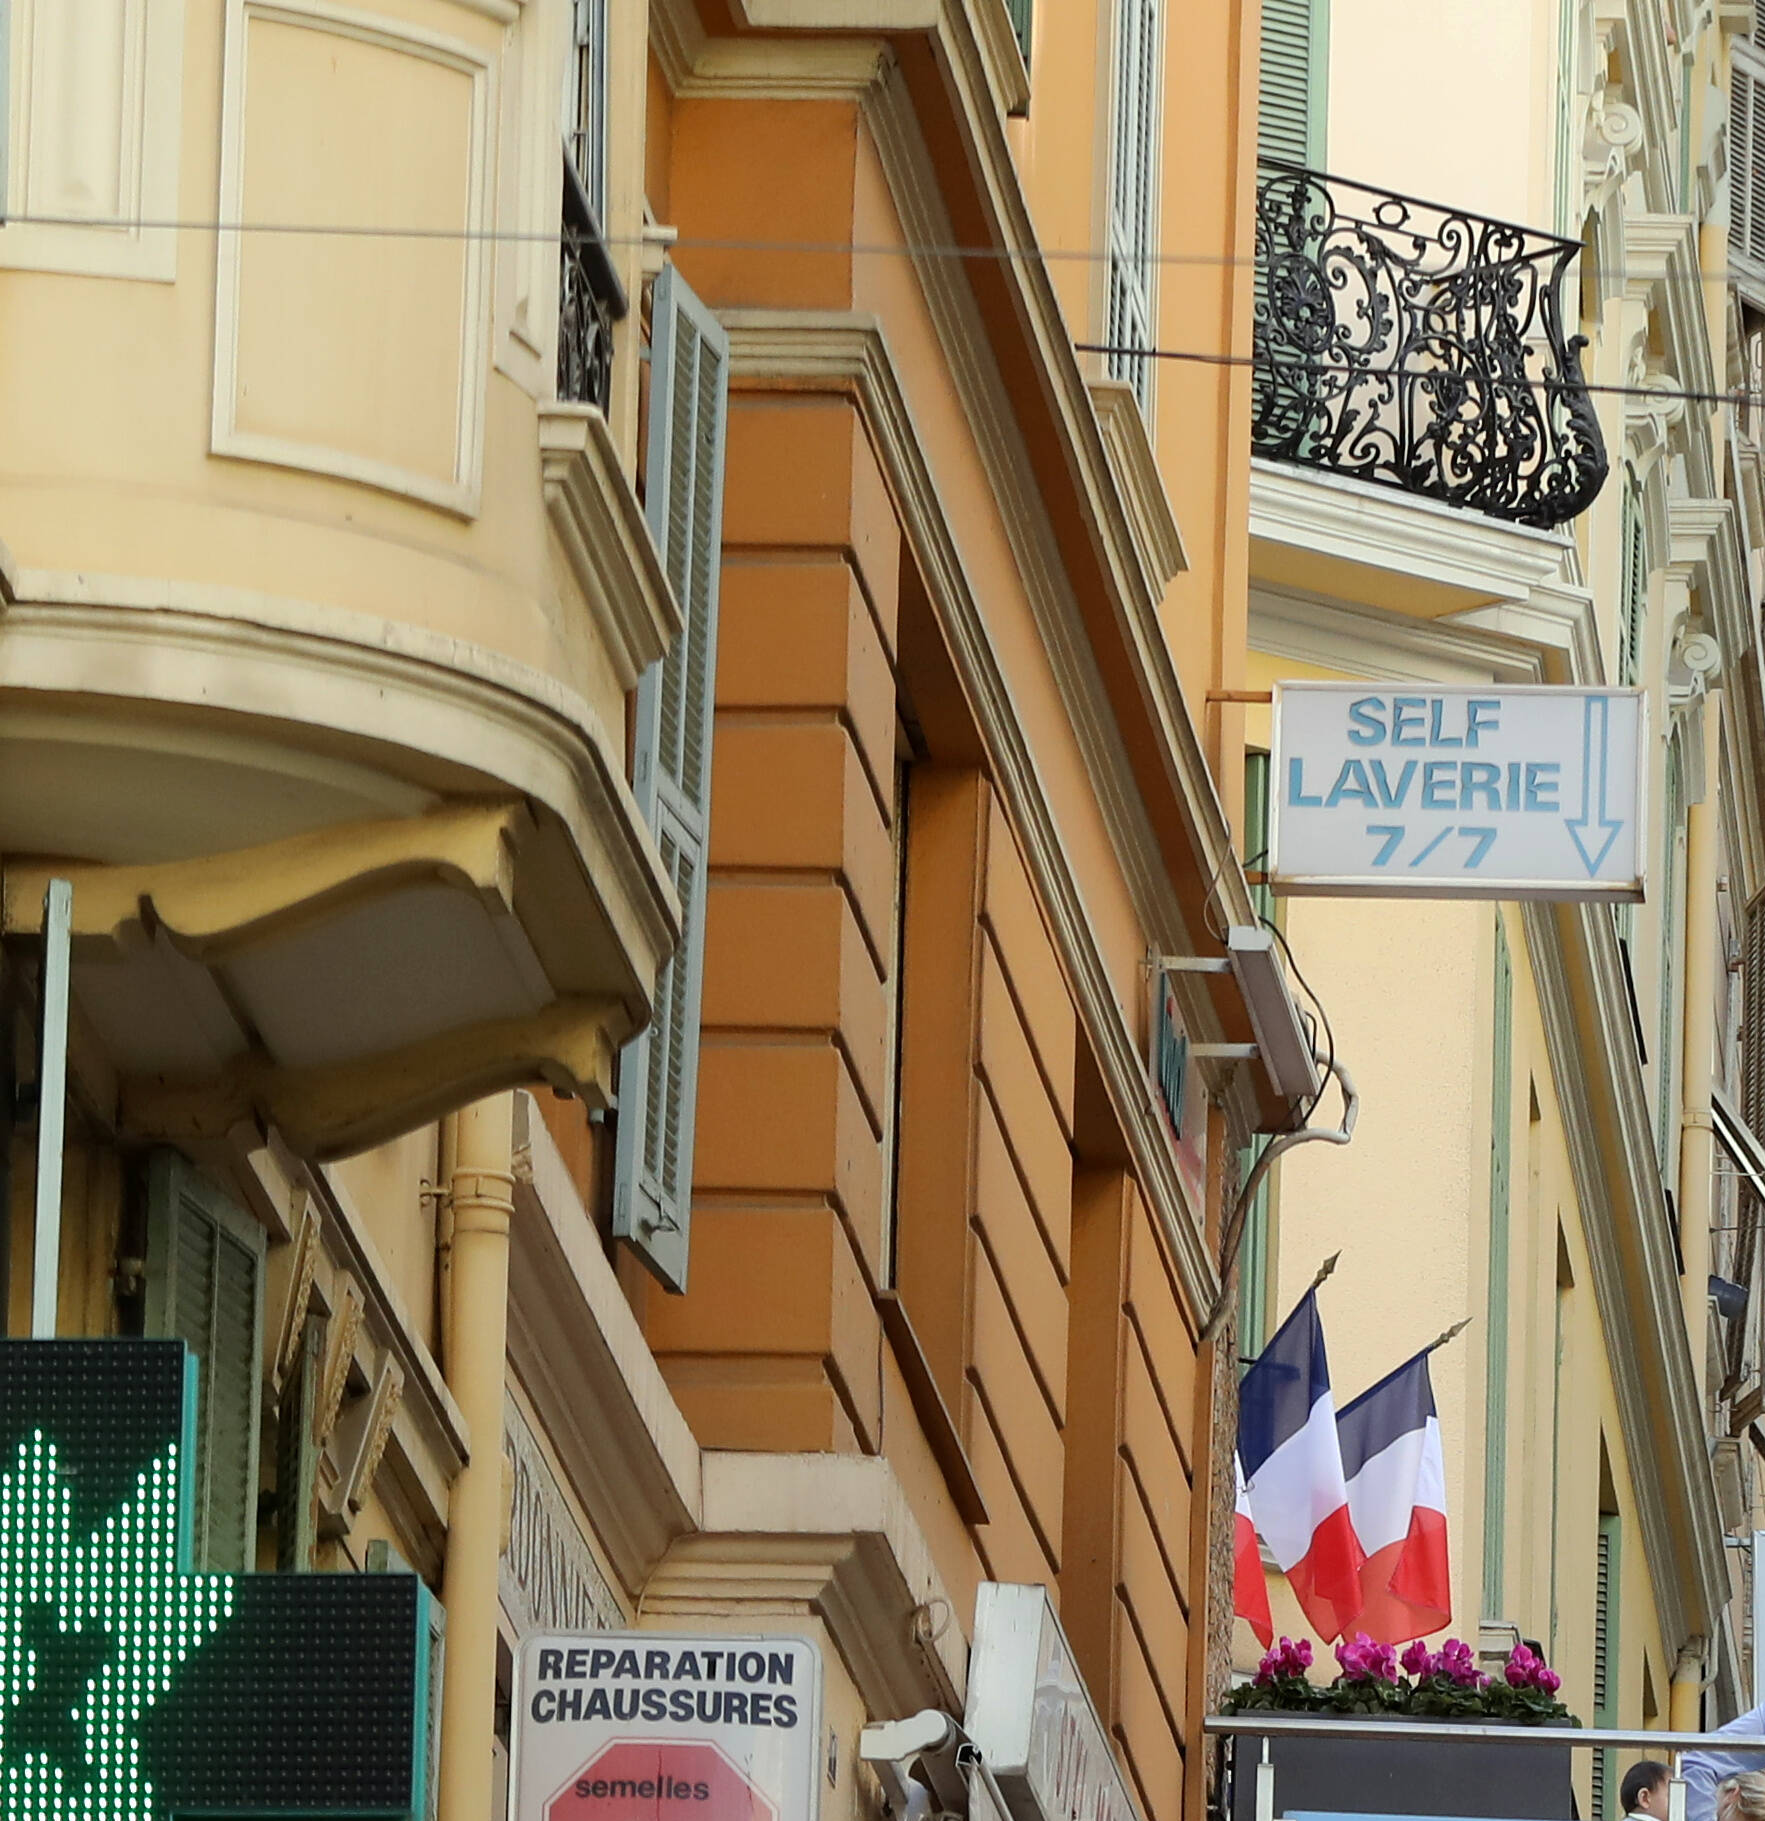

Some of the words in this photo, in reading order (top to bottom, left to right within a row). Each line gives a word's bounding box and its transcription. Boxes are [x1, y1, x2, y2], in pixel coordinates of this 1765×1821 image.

[1346, 696, 1501, 748] SELF
[1287, 757, 1561, 811] LAVERIE
[1365, 824, 1497, 868] 7/7
[537, 1648, 795, 1685] REPARATION
[530, 1688, 799, 1728] CHAUSSURES
[574, 1775, 711, 1801] semelles
